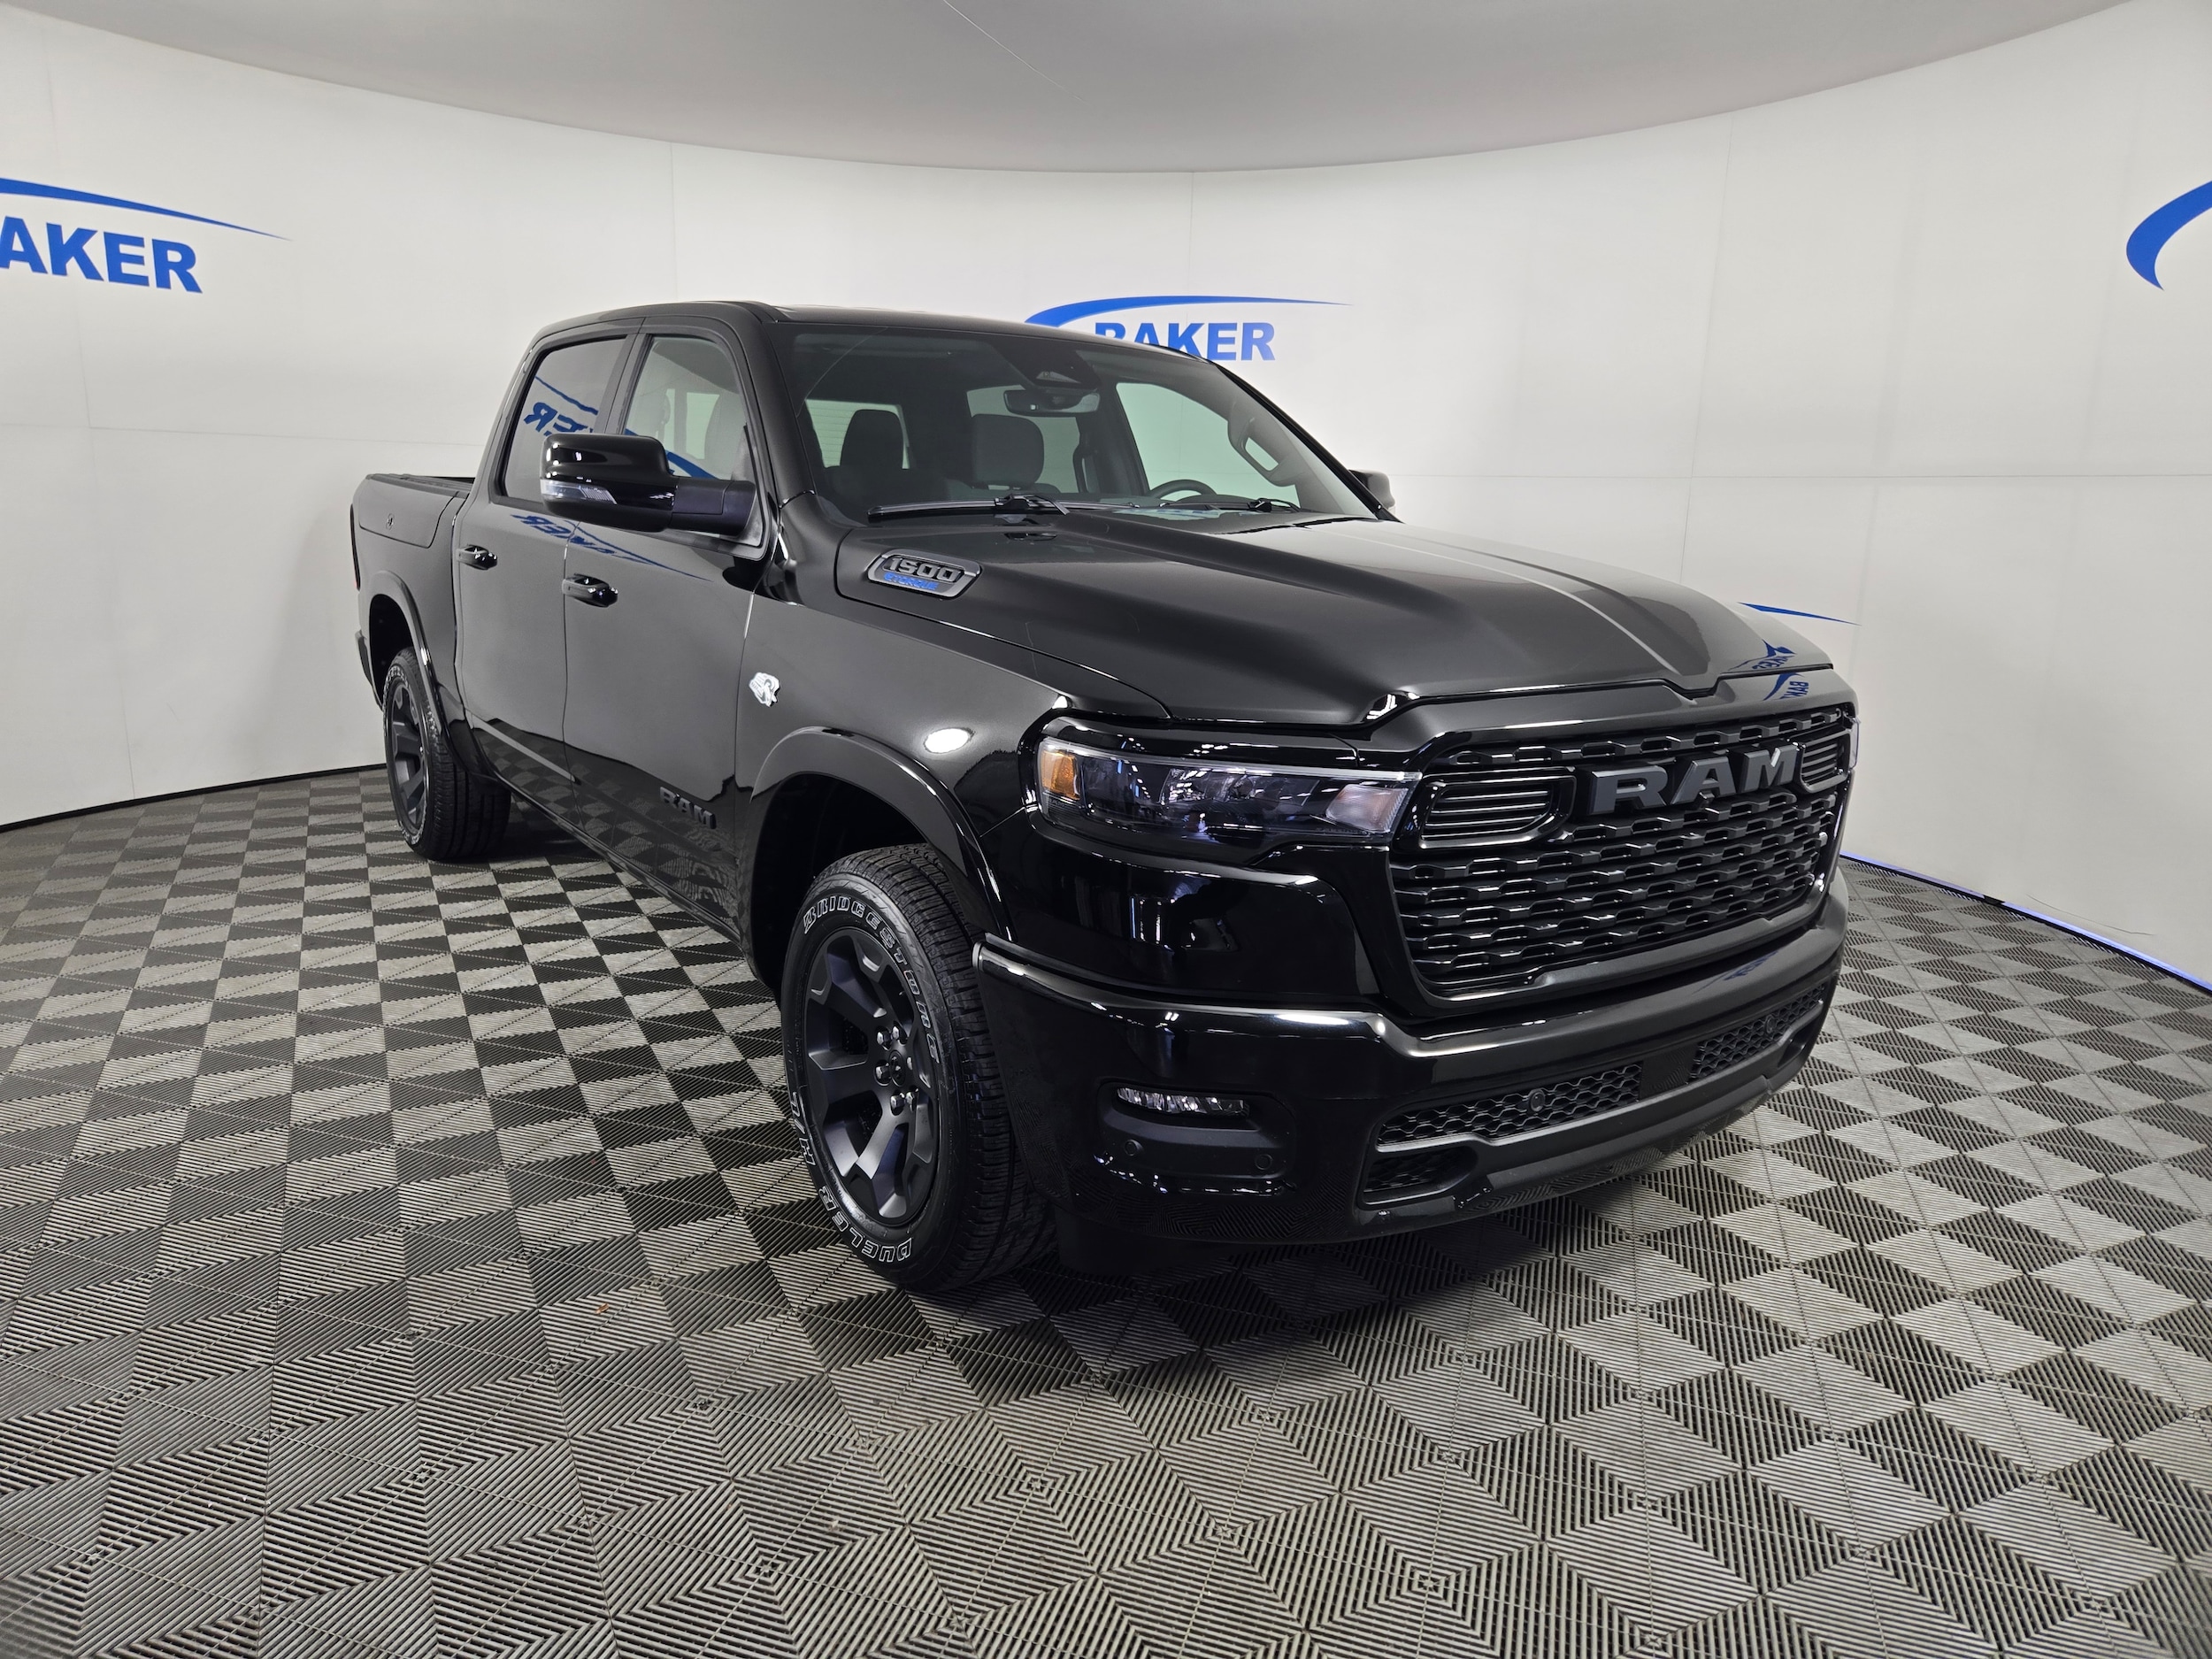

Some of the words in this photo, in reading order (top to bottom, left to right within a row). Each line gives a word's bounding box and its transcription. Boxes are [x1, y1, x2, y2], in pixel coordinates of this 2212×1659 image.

[0, 216, 203, 294] AKER
[889, 557, 961, 582] 1500
[660, 787, 716, 829] RAM
[1591, 744, 1800, 814] RAM
[803, 895, 940, 1064] BRIDGESTONE
[818, 1186, 912, 1262] DUELER
